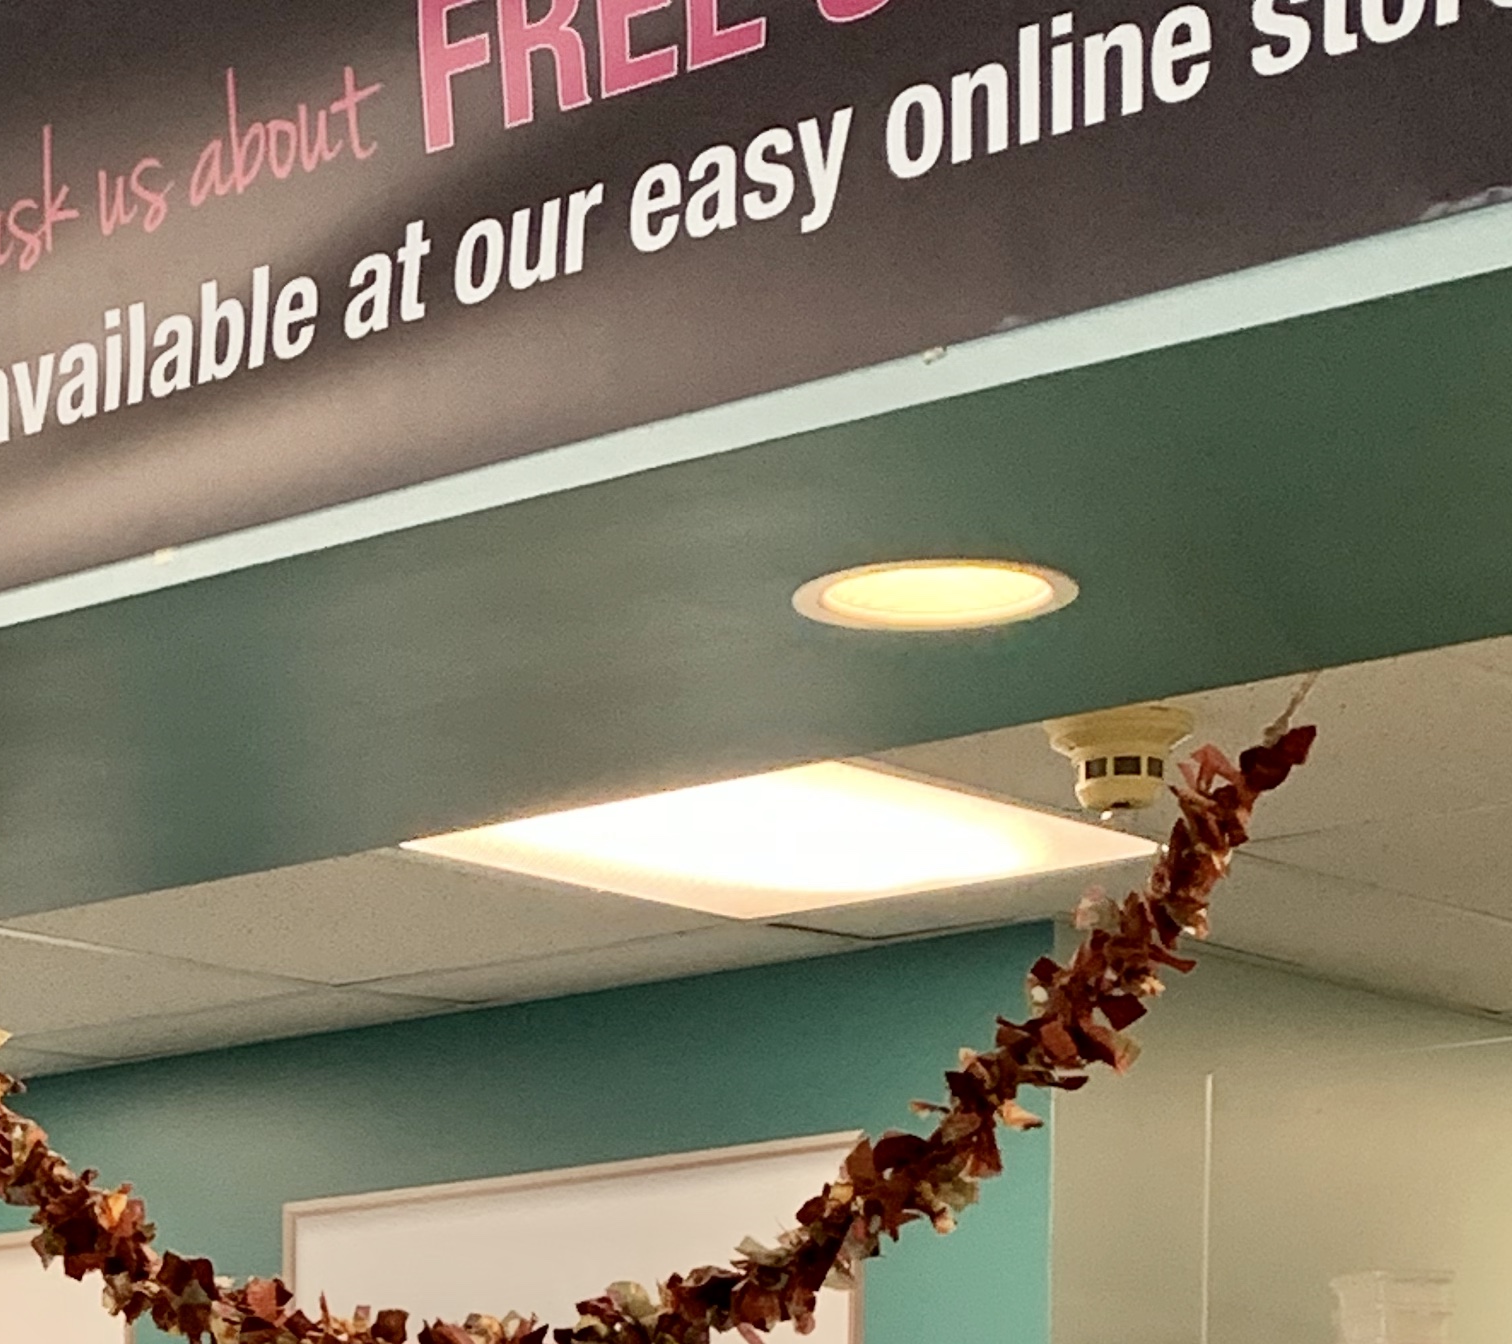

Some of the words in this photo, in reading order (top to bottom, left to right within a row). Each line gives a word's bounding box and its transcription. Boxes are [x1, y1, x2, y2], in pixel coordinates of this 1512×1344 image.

[97, 157, 175, 236] us
[189, 66, 385, 207] about
[343, 219, 431, 340] at
[453, 182, 603, 295] our
[628, 106, 854, 253] easy
[885, 3, 1212, 180] online
